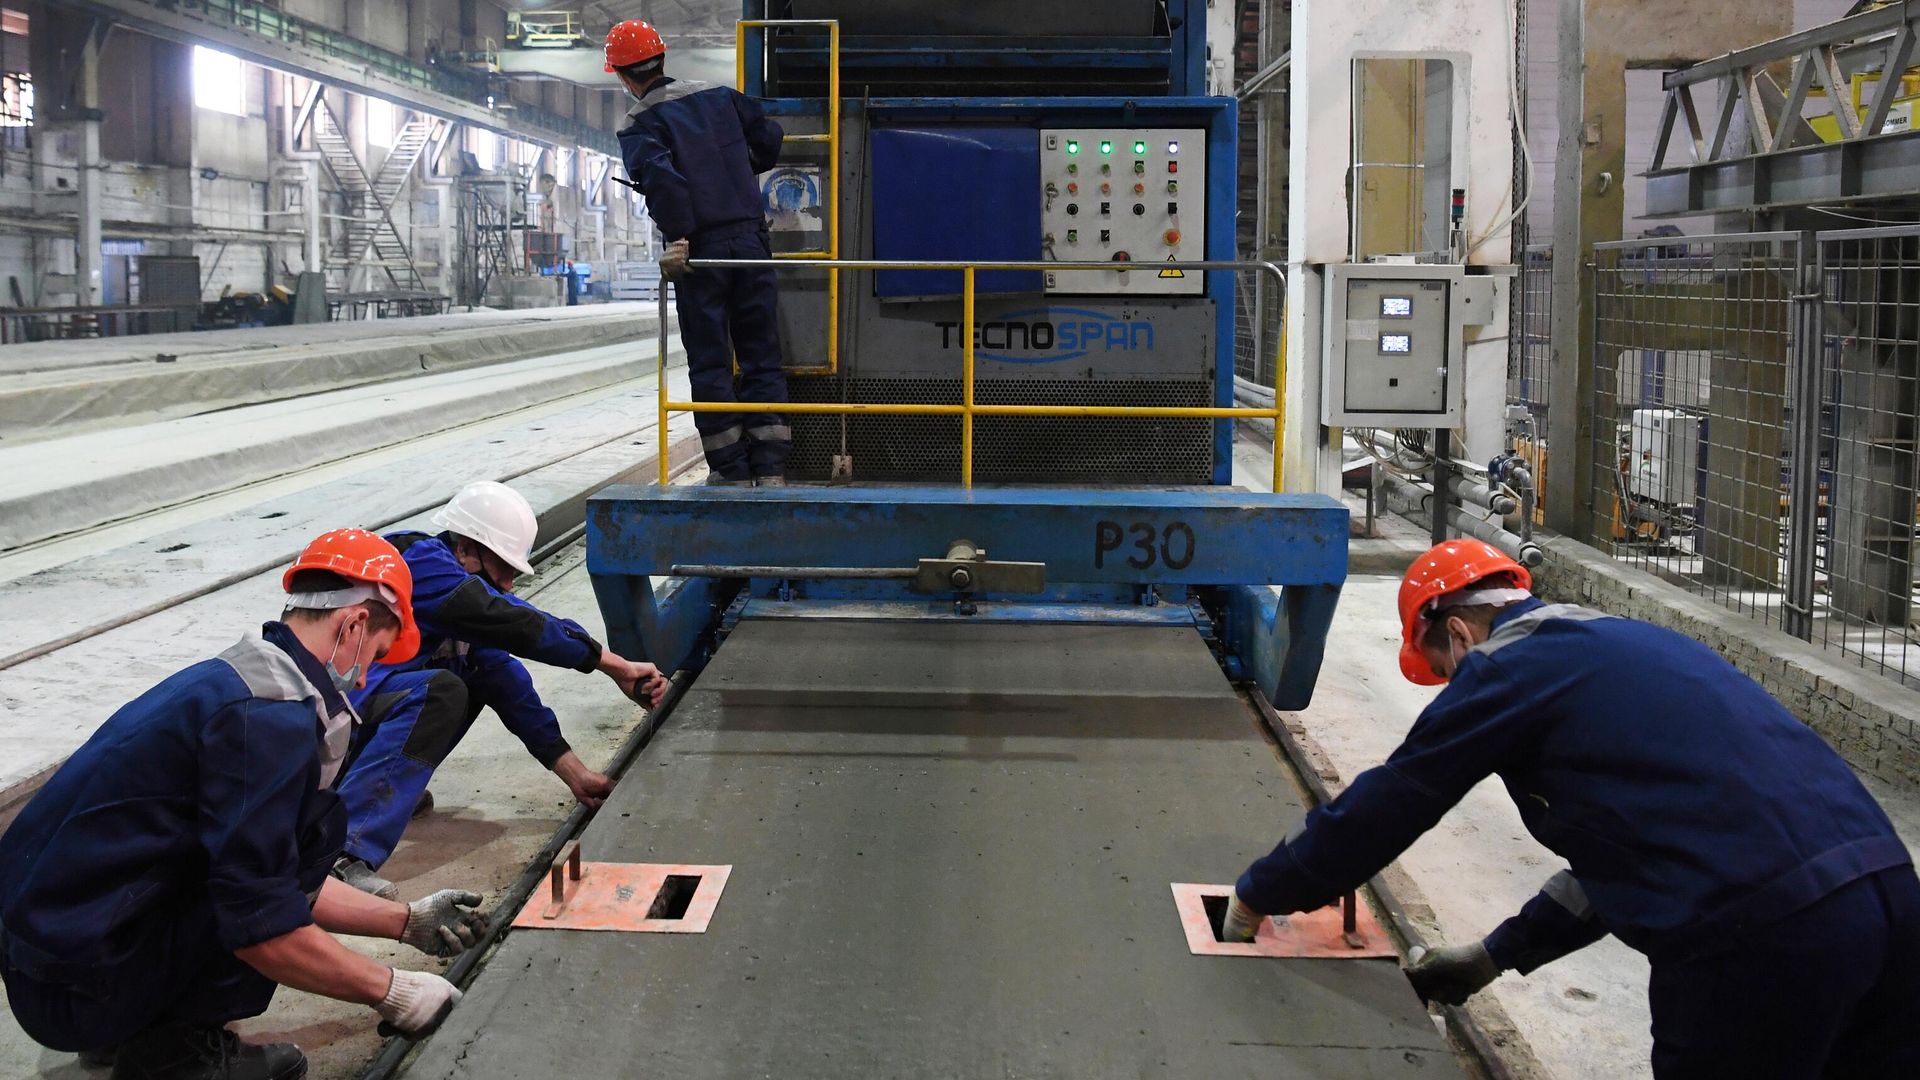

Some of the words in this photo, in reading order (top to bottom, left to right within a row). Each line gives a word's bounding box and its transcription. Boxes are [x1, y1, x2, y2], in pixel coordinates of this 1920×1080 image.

[1885, 117, 1907, 126] OMMER
[935, 322, 1153, 350] TECNOSPAN
[1095, 521, 1195, 570] P30
